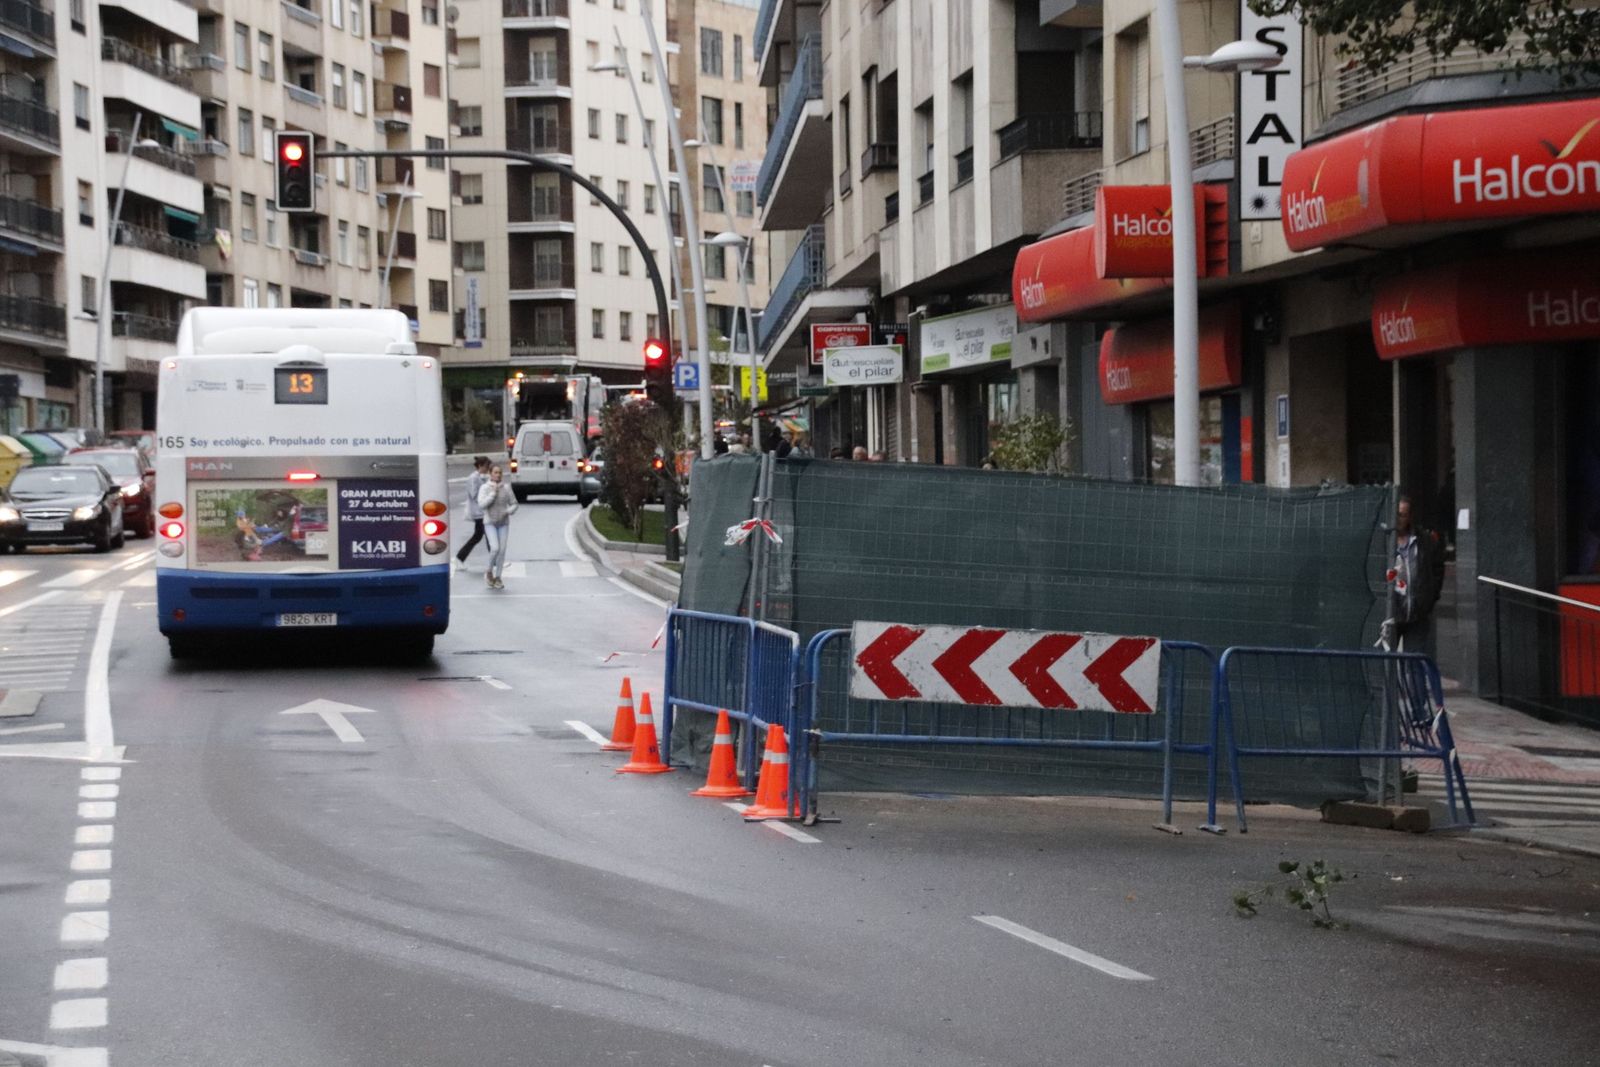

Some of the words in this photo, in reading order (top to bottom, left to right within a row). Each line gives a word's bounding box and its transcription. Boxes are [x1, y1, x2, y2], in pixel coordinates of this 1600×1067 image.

[1287, 191, 1328, 233] Halcon
[1113, 213, 1172, 237] Halco
[1528, 288, 1600, 328] Halc
[678, 365, 696, 387] P
[849, 367, 861, 377] el
[865, 366, 895, 379] pilar
[288, 373, 314, 393] 13
[158, 436, 185, 449] 165
[190, 437, 208, 448] Soy
[269, 436, 326, 448] Propulsado
[330, 438, 348, 446] con
[352, 438, 370, 448] gas
[375, 436, 411, 446] natural
[191, 462, 233, 471] MAN
[341, 489, 368, 498] GRAN
[370, 489, 415, 498] APERTURA
[348, 499, 360, 508] 27
[362, 499, 374, 508] de
[376, 499, 408, 508] octubre
[352, 540, 407, 553] KIABI
[283, 614, 310, 624] 9826
[313, 614, 334, 624] KRT
